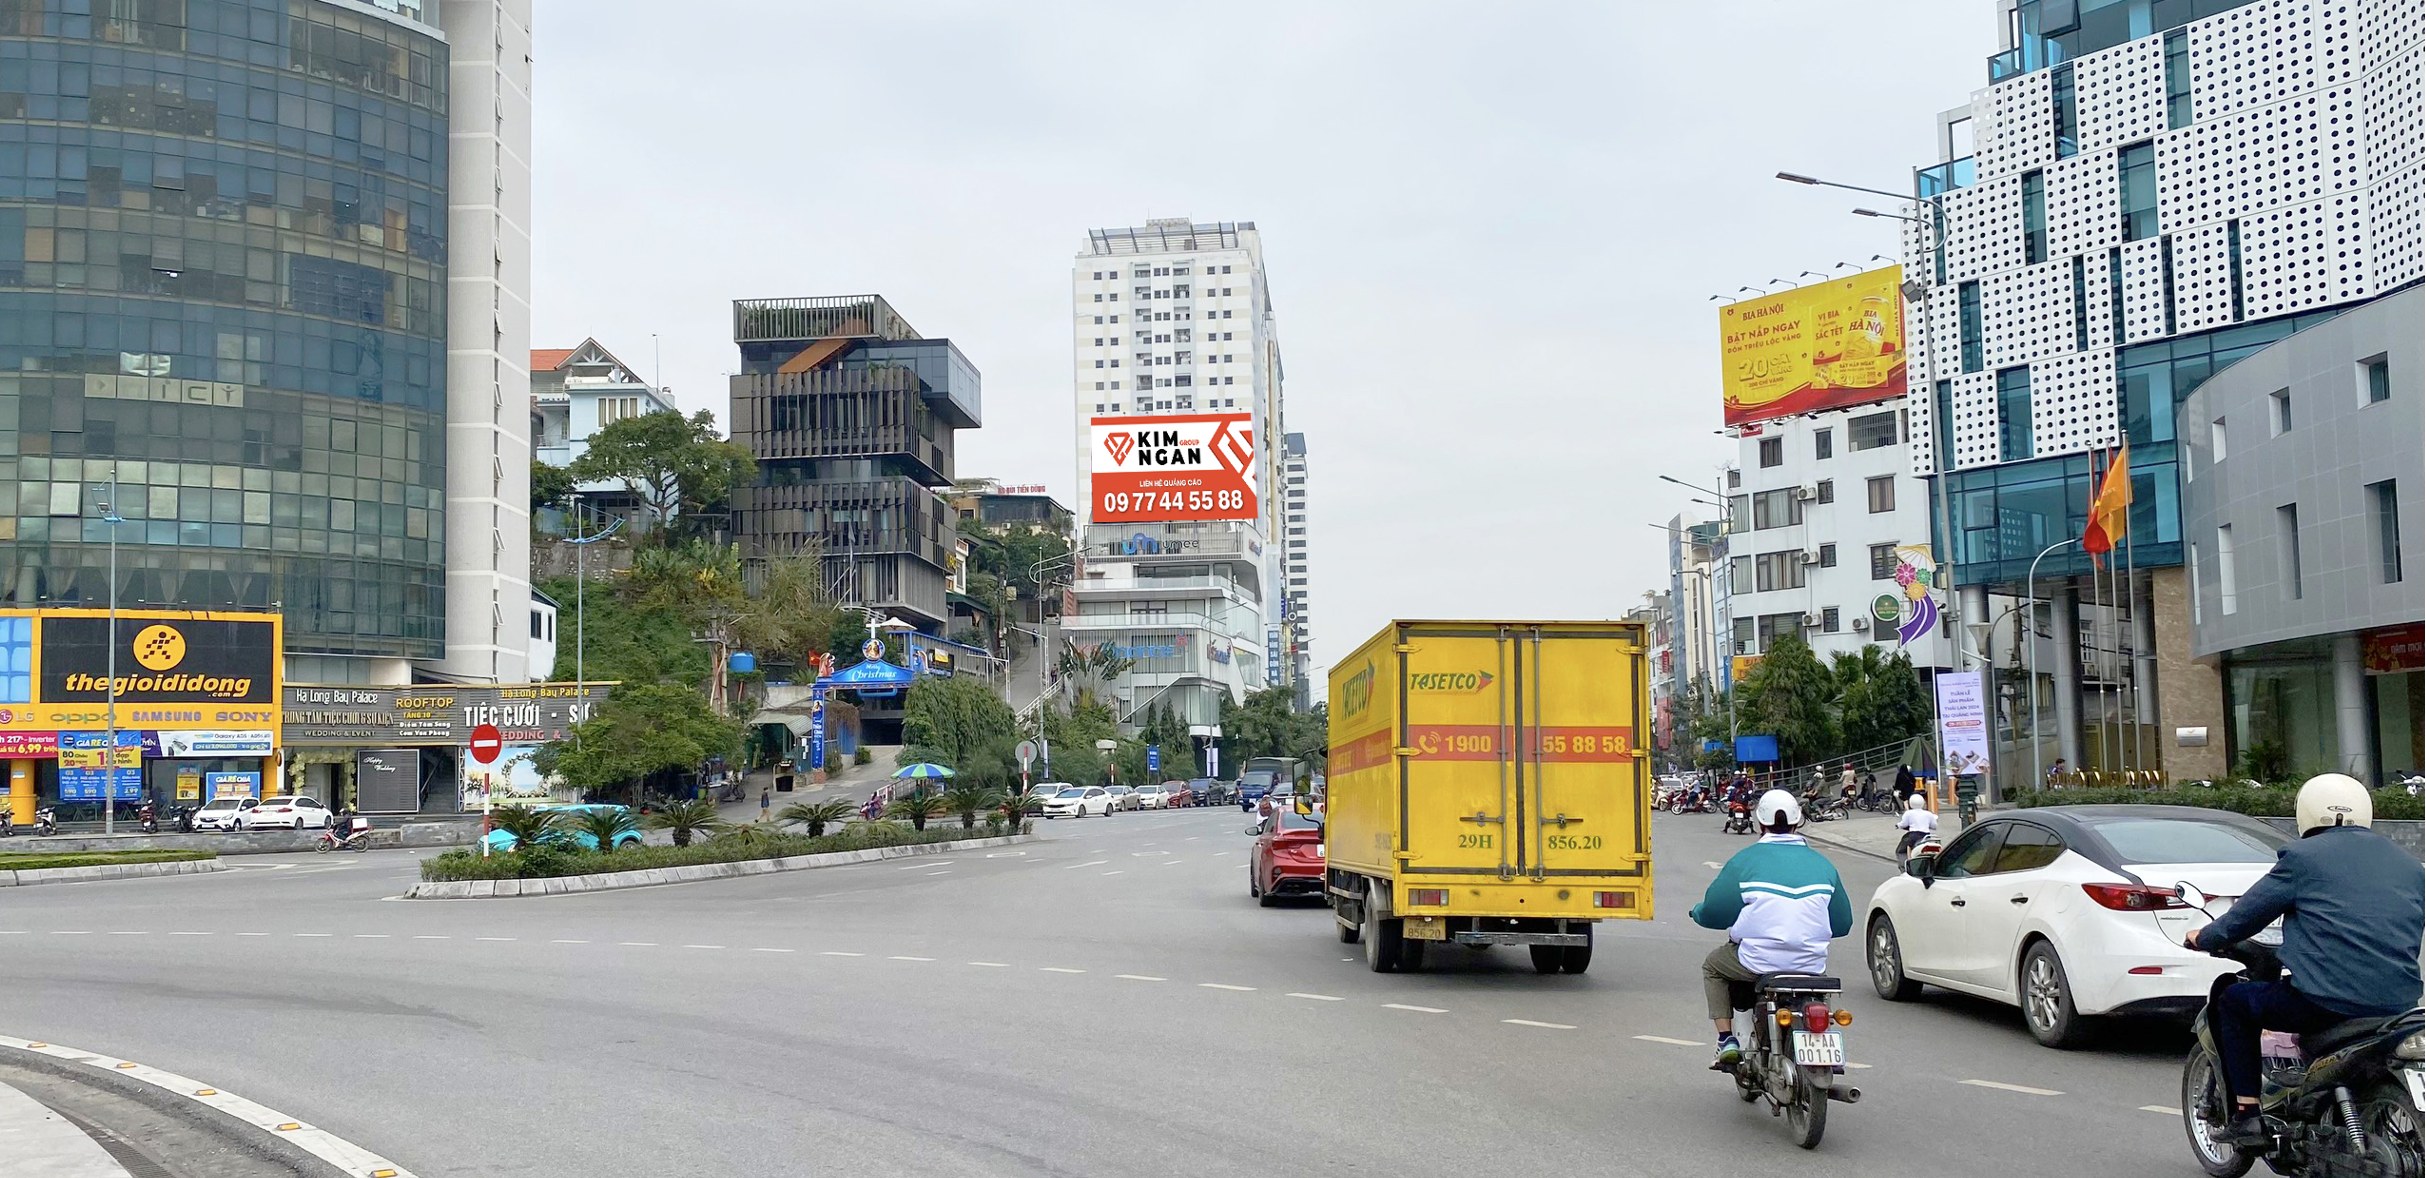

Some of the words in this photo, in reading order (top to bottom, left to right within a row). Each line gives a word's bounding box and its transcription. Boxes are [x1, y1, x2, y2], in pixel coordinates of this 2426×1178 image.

[1742, 311, 1756, 321] BIA
[1756, 306, 1768, 318] HÀ
[1769, 303, 1784, 315] NỘI
[1827, 310, 1840, 319] BIA
[1863, 310, 1877, 318] BIA
[1772, 320, 1801, 334] NGAY
[1848, 318, 1864, 331] HÀ
[1865, 320, 1885, 336] NỘI
[1738, 358, 1769, 382] 20
[1137, 430, 1178, 448] KIM
[1138, 448, 1202, 466] NGAN
[1104, 492, 1129, 513] 09
[1132, 491, 1157, 512] 77
[1159, 491, 1184, 511] 44
[1188, 490, 1213, 510] 55
[1218, 489, 1243, 510] 88
[1162, 540, 1199, 549] umee
[851, 670, 897, 682] Christmas
[1410, 673, 1477, 690] TASETCO
[66, 673, 251, 698] thegioididong
[540, 688, 557, 698] Bay
[559, 687, 590, 697] Palae
[296, 689, 307, 704] Hạ
[310, 689, 330, 705] Long
[333, 690, 349, 705] Bay
[352, 691, 378, 704] Palace
[396, 697, 454, 708] ROOFTOP
[16, 712, 35, 722] LG
[132, 711, 202, 722] SAMSUNG
[215, 711, 272, 722] SONY
[503, 704, 540, 727] CƯỚI
[499, 729, 545, 741] EDDING
[18, 743, 42, 755] 6,99
[1445, 735, 1492, 753] 1900
[1543, 736, 1566, 753] 55
[1573, 736, 1595, 753] 88
[1603, 736, 1625, 753] 58
[97, 752, 105, 766] 1
[1458, 834, 1493, 849] 29H
[1548, 835, 1601, 850] 856.20
[1407, 928, 1441, 938] 856.20
[1801, 1034, 1835, 1048] 14-AA
[1798, 1049, 1841, 1063] 001.16
